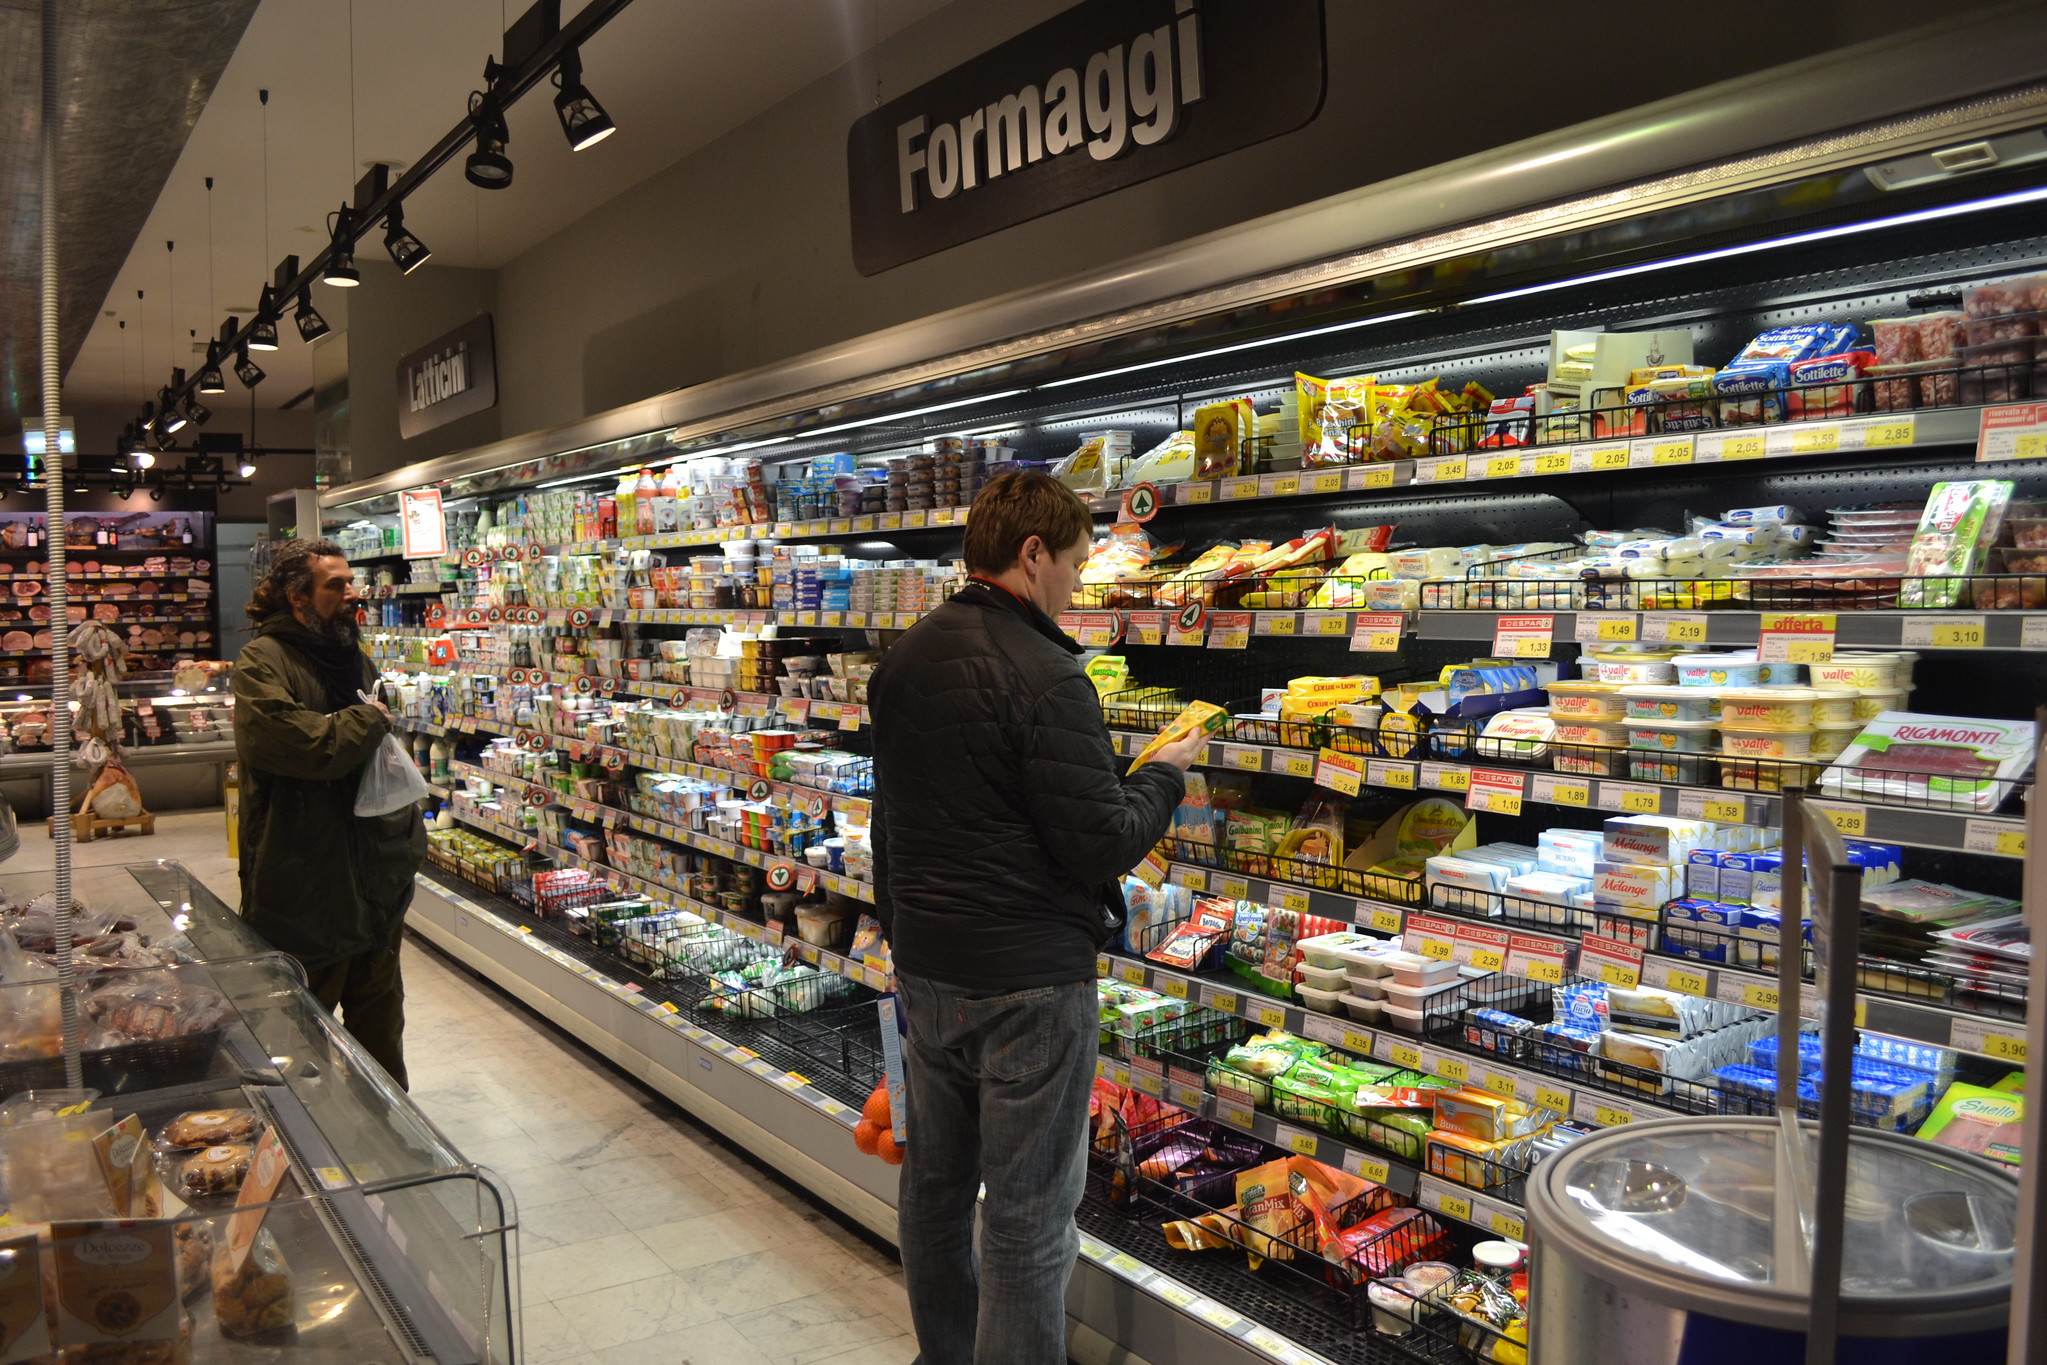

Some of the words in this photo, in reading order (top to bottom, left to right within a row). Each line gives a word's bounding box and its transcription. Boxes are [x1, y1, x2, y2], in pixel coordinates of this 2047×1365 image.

[897, 0, 1203, 214] Formaggi
[408, 341, 468, 413] Latticini
[1796, 365, 1846, 383] Sottilette
[1717, 381, 1766, 395] Sottilette
[1811, 433, 1835, 446] 3,59
[1884, 428, 1910, 441] 2,85
[1668, 447, 1690, 459] 2,05
[1736, 442, 1758, 454] 2,05
[1547, 458, 1565, 469] 2,35
[1605, 453, 1625, 465] 2,05
[1445, 465, 1461, 475] 3,45
[1497, 460, 1515, 471] 2,05
[1325, 478, 1339, 488] 2,05
[1375, 473, 1390, 483] 3,79
[1243, 484, 1256, 493] 2,75
[1328, 620, 1342, 629] 3,79
[1505, 619, 1542, 627] DESPAR
[1773, 618, 1823, 632] offerta
[1611, 625, 1630, 636] 1,49
[1679, 626, 1700, 638] 2,19
[1379, 637, 1394, 645] 2,45
[1952, 631, 1979, 643] 3,10
[1530, 642, 1547, 653] 1,33
[1810, 651, 1831, 663] 1,99
[1608, 665, 1630, 676] valle
[1686, 668, 1708, 677] valle
[1822, 669, 1854, 682] valle
[1341, 682, 1356, 690] LION
[1563, 697, 1590, 708] valle
[1736, 705, 1770, 717] valle
[1495, 723, 1546, 736] Margarina
[1565, 726, 1590, 736] valle
[1636, 731, 1658, 739] valle
[1893, 725, 2001, 746] RIGAMONTI
[1743, 738, 1773, 749] valle
[1245, 755, 1258, 764] 2,29
[1327, 754, 1356, 770] offerta
[1295, 763, 1309, 772] 2,65
[1395, 774, 1409, 784] 1,85
[1450, 775, 1466, 784] 1,85
[1479, 773, 1514, 784] DESPAR
[1567, 790, 1585, 801] 1,89
[1502, 799, 1519, 810] 1,10
[1634, 797, 1654, 808] 1,79
[1717, 805, 1738, 817] 1,58
[1228, 822, 1262, 836] Galbanino
[1836, 817, 1860, 829] 2,89
[1611, 837, 1661, 855] Mélange
[1555, 853, 1576, 863] BURRO
[1601, 878, 1648, 898] Mélange
[1755, 880, 1777, 893] Butter
[1381, 916, 1396, 927] 2,95
[1703, 913, 1721, 921] MEGGLE
[1414, 919, 1447, 932] DESPAR
[1602, 919, 1647, 940] Mélange
[1759, 925, 1778, 935] MEGGLE
[1464, 929, 1498, 942] DESPAR
[1432, 945, 1449, 956] 3,99
[1518, 939, 1554, 951] DESPAR
[1591, 939, 1631, 957] DESPAR
[1483, 956, 1499, 967] 2,29
[1542, 967, 1559, 979] 1,35
[1615, 971, 1633, 984] 1,29
[1680, 977, 1700, 990] 1,72
[1756, 991, 1778, 1005] 2,99
[1352, 1037, 1367, 1048] 2,35
[1999, 1041, 2026, 1056] 3,90
[1402, 1052, 1417, 1064] 2,35
[1447, 1064, 1462, 1076] 3,11
[1497, 1080, 1514, 1093] 3,11
[1546, 1094, 1564, 1107] 2,44
[1959, 1100, 2017, 1119] Snello
[1609, 1112, 1628, 1124] 2,19
[1440, 1119, 1464, 1133] Burro
[1299, 1139, 1313, 1150] 3,65
[1368, 1166, 1384, 1178] 6,65
[1431, 1161, 1453, 1175] Burro
[1244, 1198, 1285, 1218] GranMix
[1449, 1201, 1465, 1214] 2,99
[1503, 1222, 1521, 1236] 1,75
[83, 1241, 145, 1254] Dolcezze
